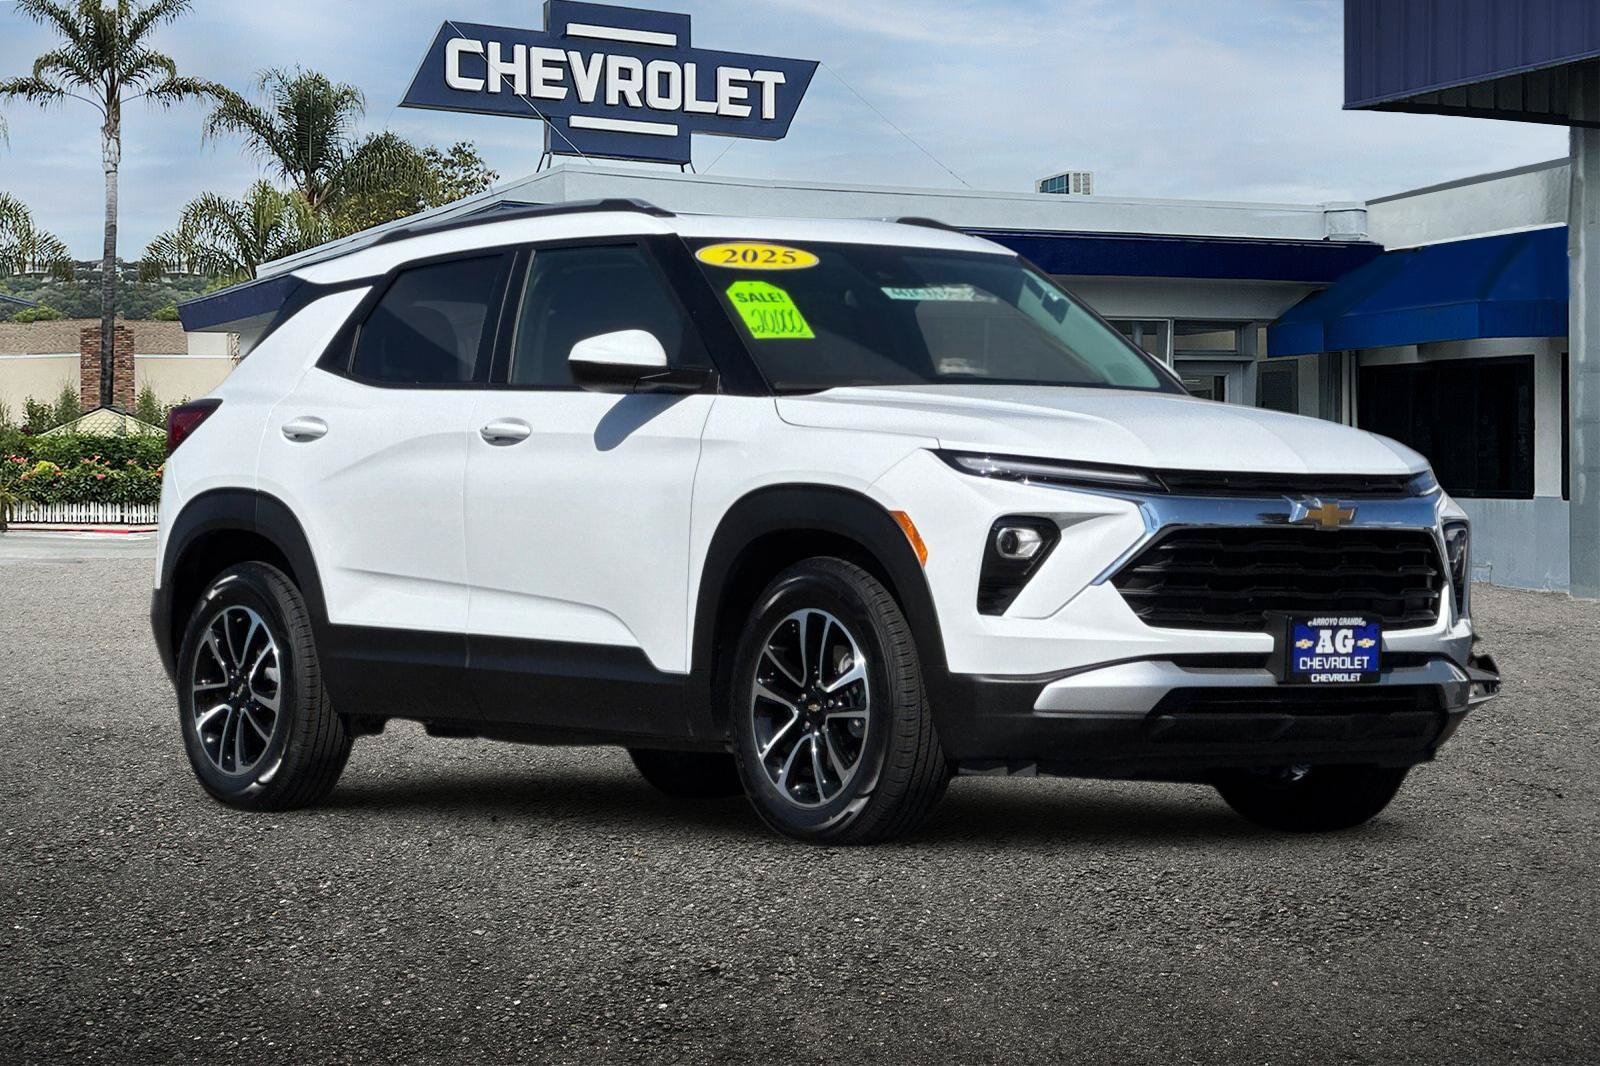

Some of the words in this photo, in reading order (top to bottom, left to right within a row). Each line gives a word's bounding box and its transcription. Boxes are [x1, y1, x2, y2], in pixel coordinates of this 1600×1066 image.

[445, 37, 786, 120] CHEVROLET
[721, 249, 797, 265] 2025
[735, 292, 785, 303] SALE!
[1312, 617, 1338, 626] ARROYO
[1338, 617, 1363, 626] GRANDE
[1315, 629, 1355, 654] AG
[1299, 656, 1370, 670] CHEVROLET
[1311, 673, 1362, 683] CHEVROLET
